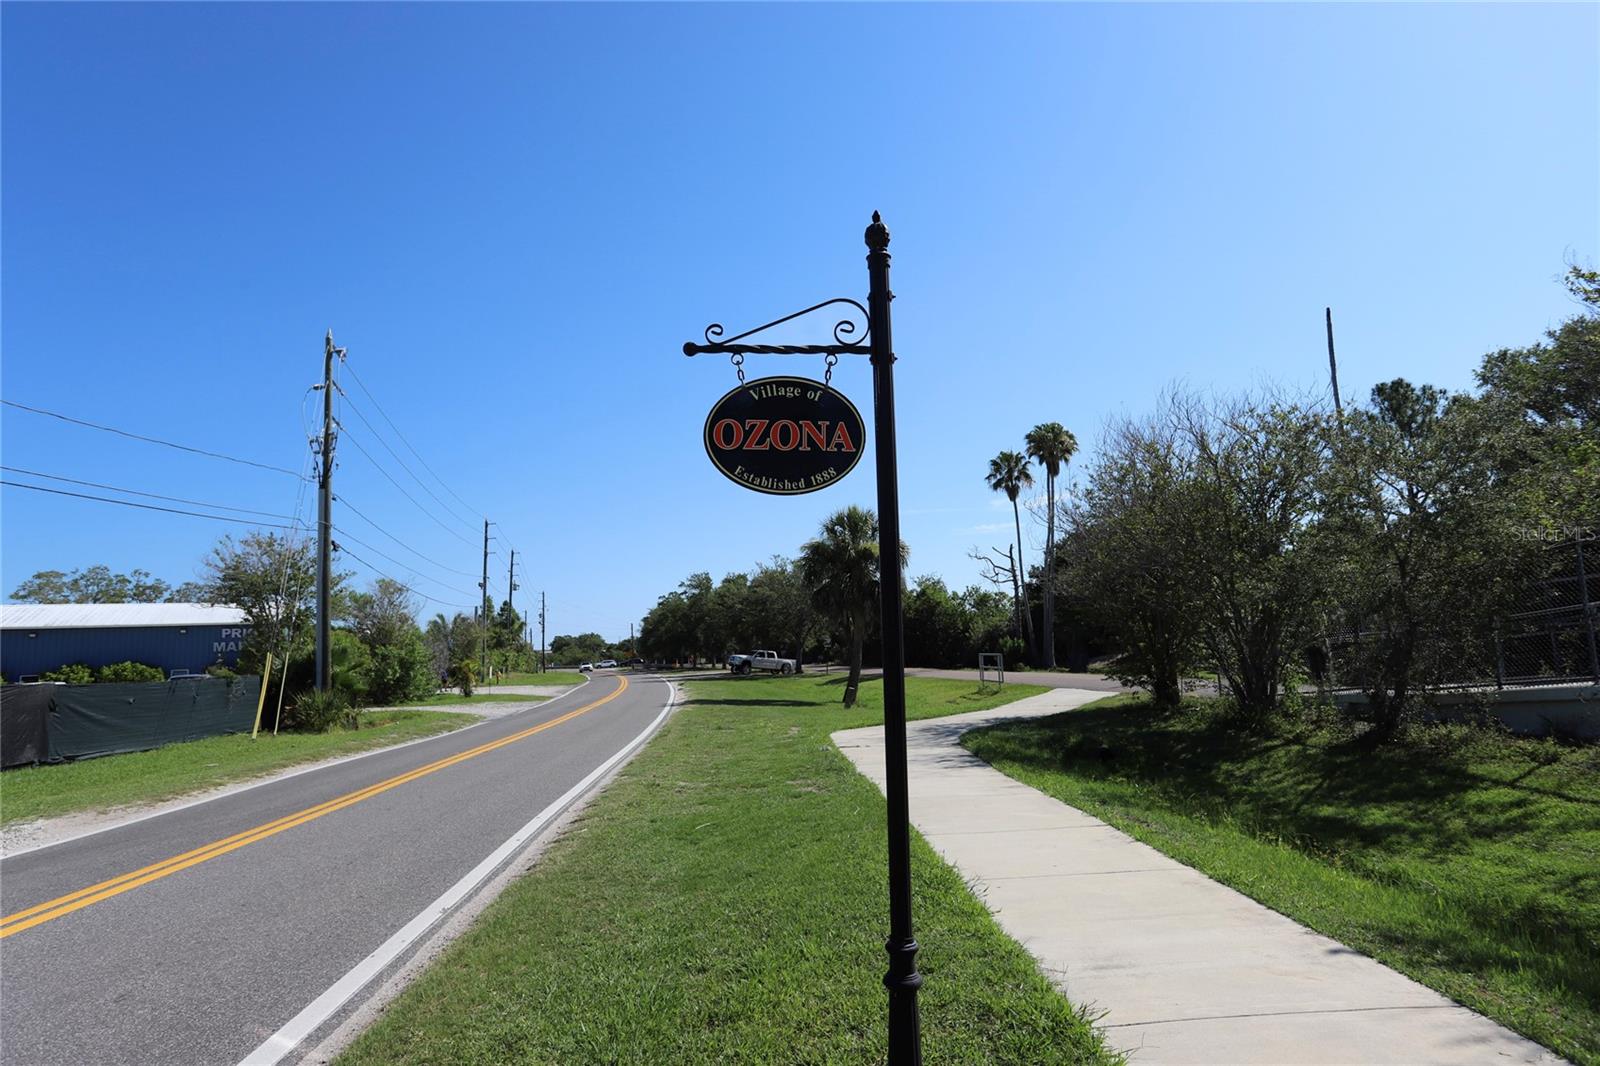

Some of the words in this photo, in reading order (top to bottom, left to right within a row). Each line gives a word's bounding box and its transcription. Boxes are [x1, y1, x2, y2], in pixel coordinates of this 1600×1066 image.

[749, 384, 801, 401] Village
[807, 390, 823, 401] of
[713, 418, 856, 452] OZONA
[734, 465, 806, 490] Established
[810, 466, 837, 486] 1888
